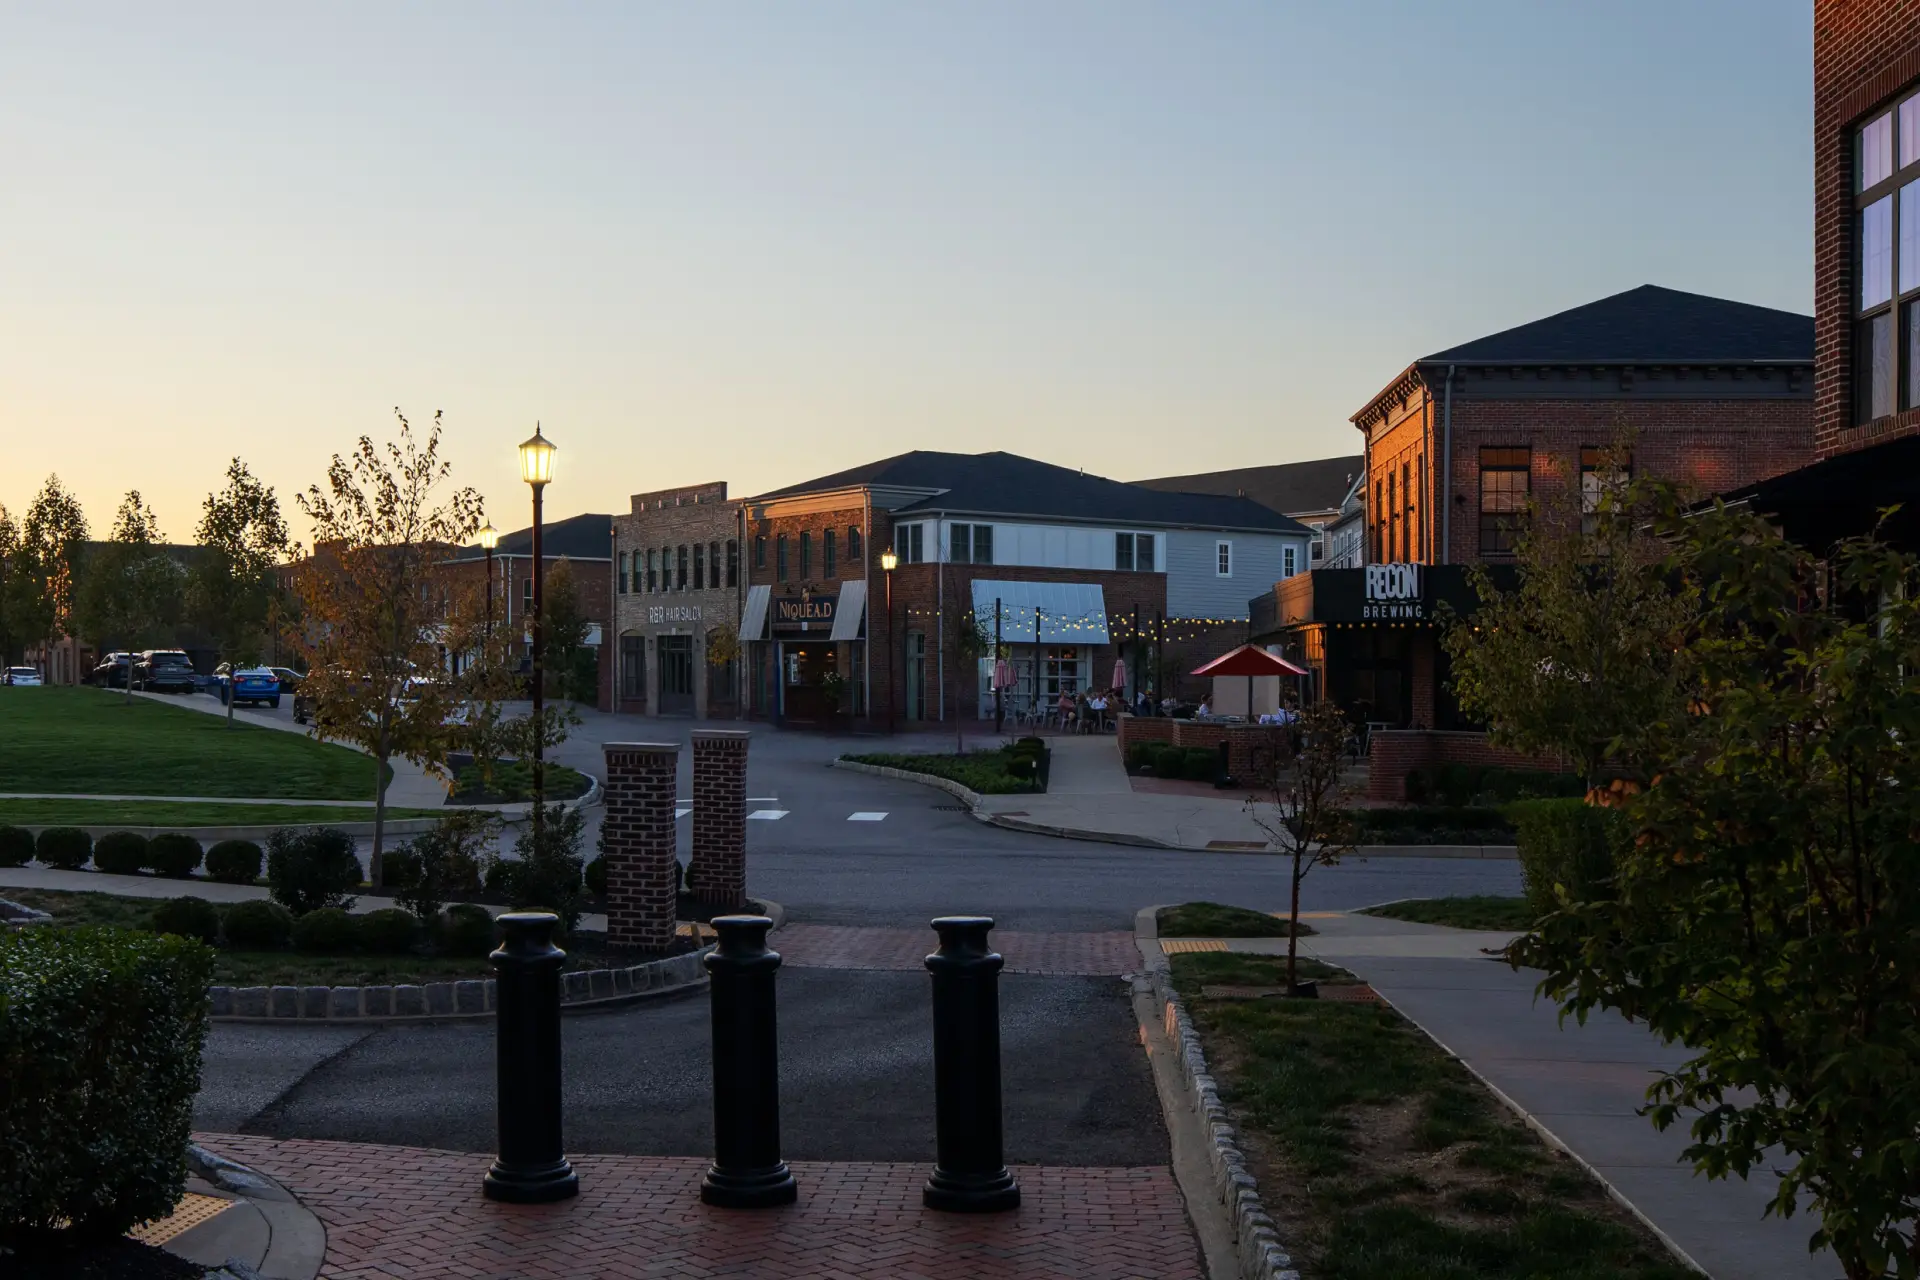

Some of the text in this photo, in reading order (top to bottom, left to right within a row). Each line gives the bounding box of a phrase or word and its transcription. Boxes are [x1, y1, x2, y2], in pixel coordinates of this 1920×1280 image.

[1366, 563, 1418, 599] RECON
[649, 606, 702, 624] R&R HAIR SALON
[1363, 605, 1422, 618] BREWING
